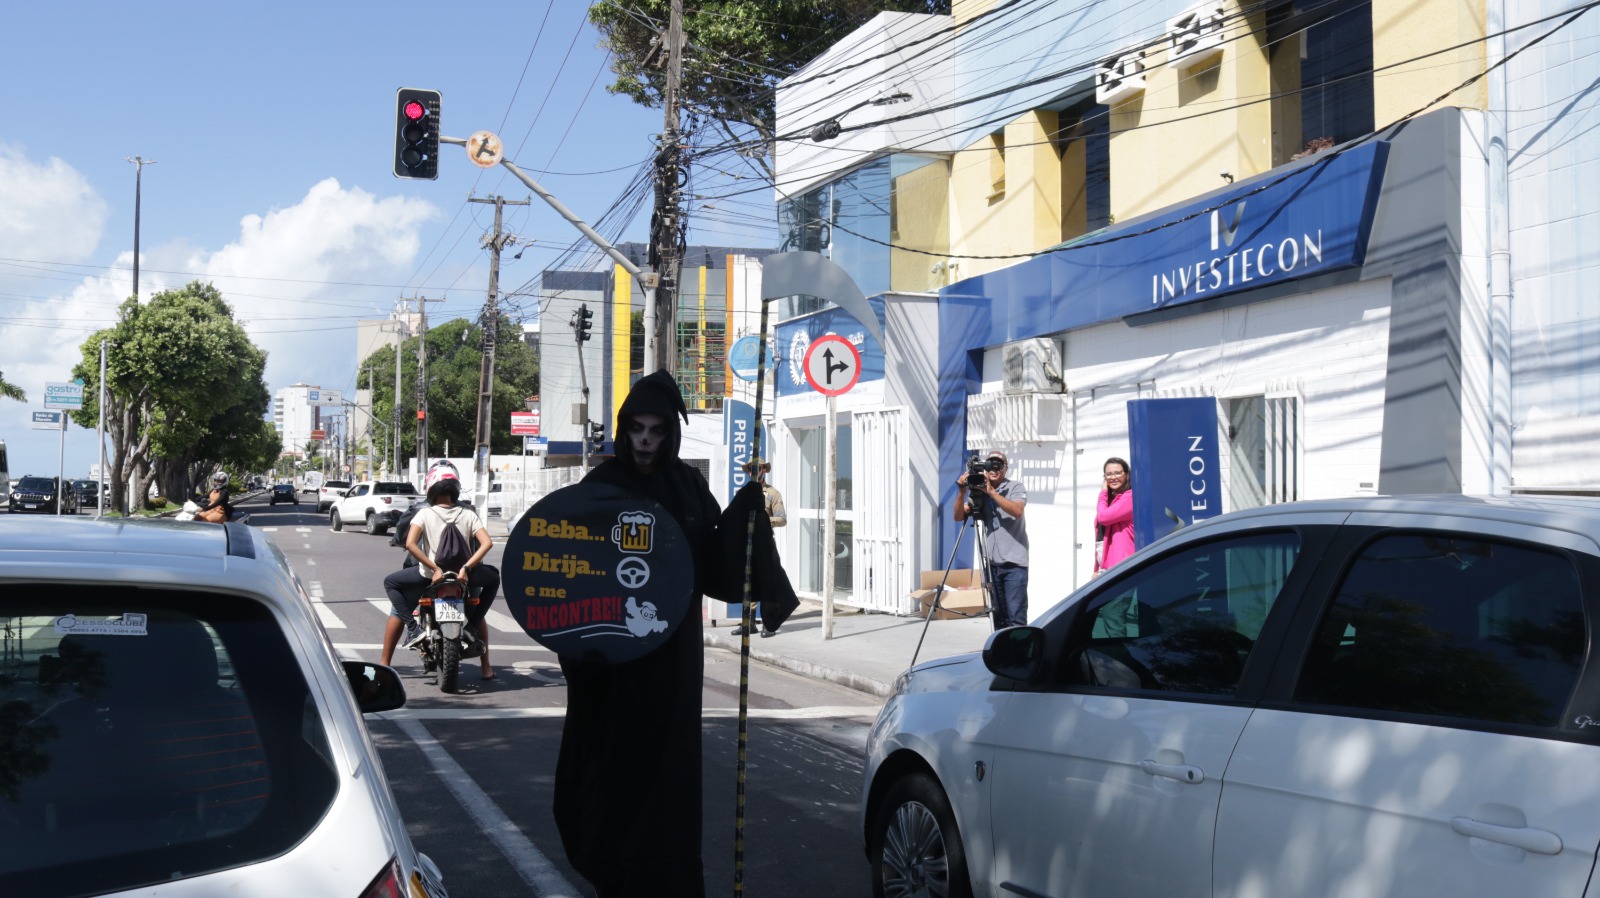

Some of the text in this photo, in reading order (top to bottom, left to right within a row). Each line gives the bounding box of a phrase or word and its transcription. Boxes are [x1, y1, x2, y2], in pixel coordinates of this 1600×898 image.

[1153, 229, 1322, 304] INVESTECON
[529, 517, 605, 542] Beba...
[522, 551, 607, 579] Dirija...
[524, 585, 567, 599] e me
[439, 611, 462, 620] 7A82
[526, 596, 622, 630] ENCONTRE!!
